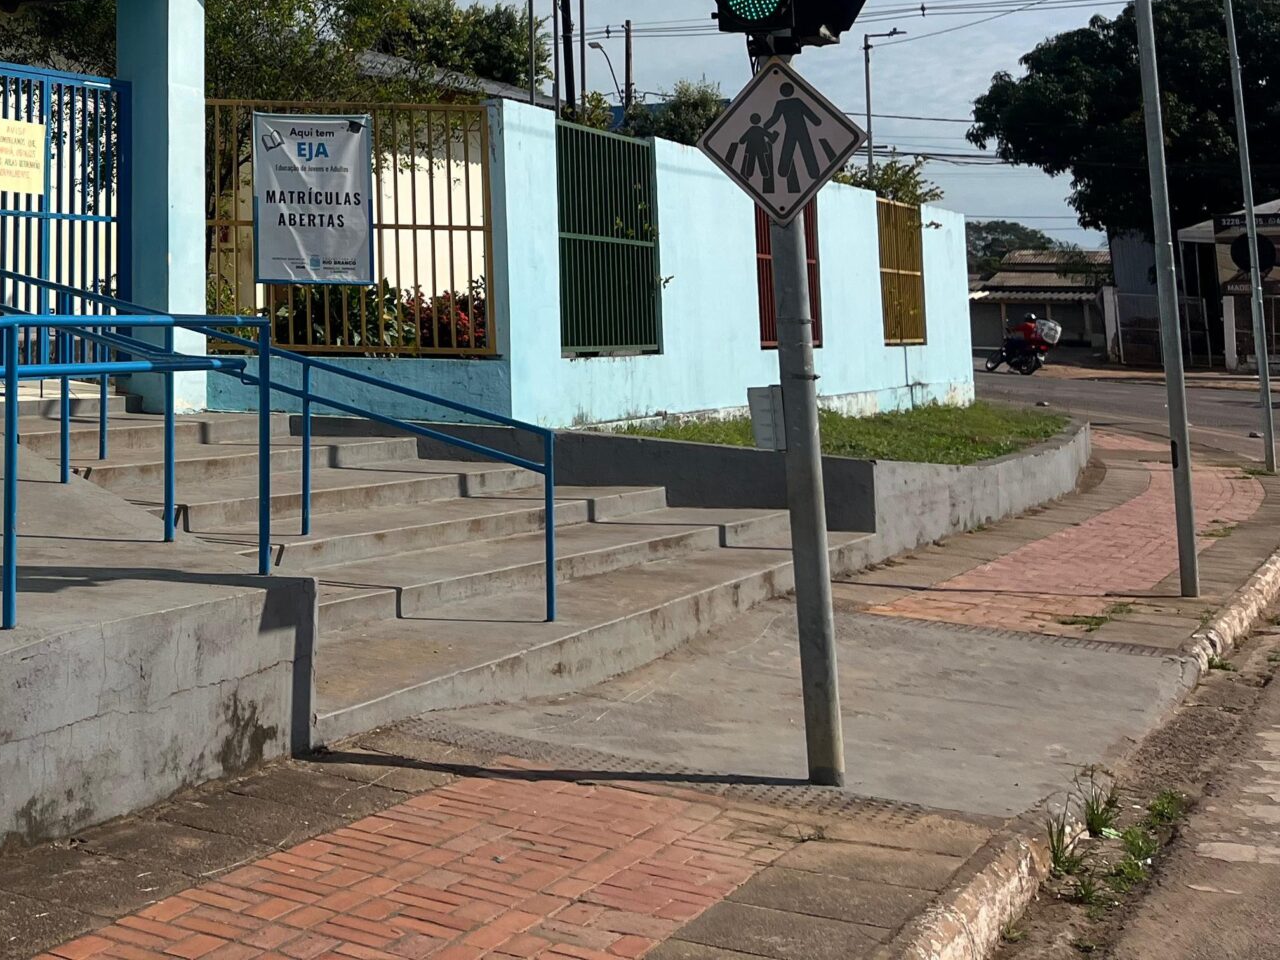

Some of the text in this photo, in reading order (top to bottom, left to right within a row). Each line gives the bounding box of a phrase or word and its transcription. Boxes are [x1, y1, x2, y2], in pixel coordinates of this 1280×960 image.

[289, 127, 335, 139] Aqui tem
[296, 141, 330, 162] EJA
[265, 187, 362, 206] MATRÍCULAS
[277, 212, 345, 228] ABERTAS
